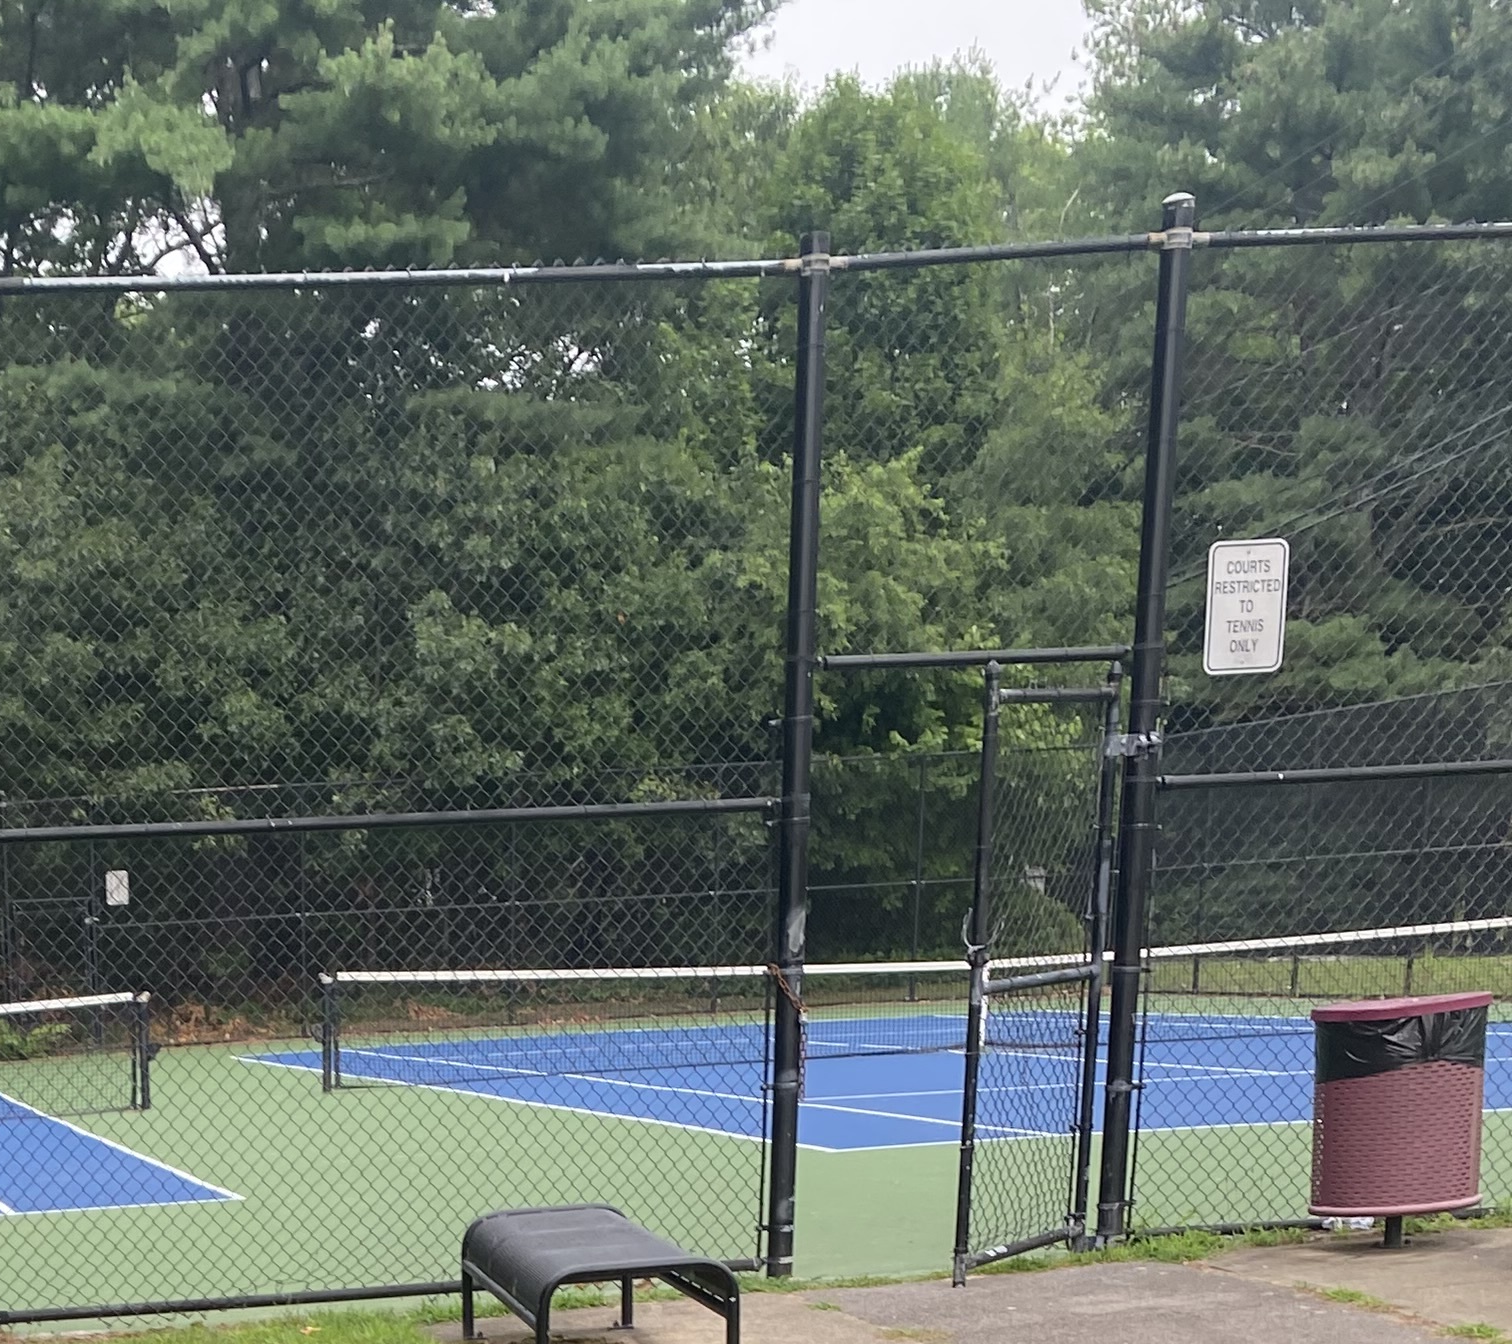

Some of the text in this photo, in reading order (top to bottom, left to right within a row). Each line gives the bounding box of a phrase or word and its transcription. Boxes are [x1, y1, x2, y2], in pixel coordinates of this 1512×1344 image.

[1226, 560, 1270, 575] COURTS
[1215, 579, 1280, 595] RESTRICTED
[1239, 599, 1254, 613] TO
[1226, 619, 1264, 633] TENNIS
[1229, 639, 1259, 653] ONLY
